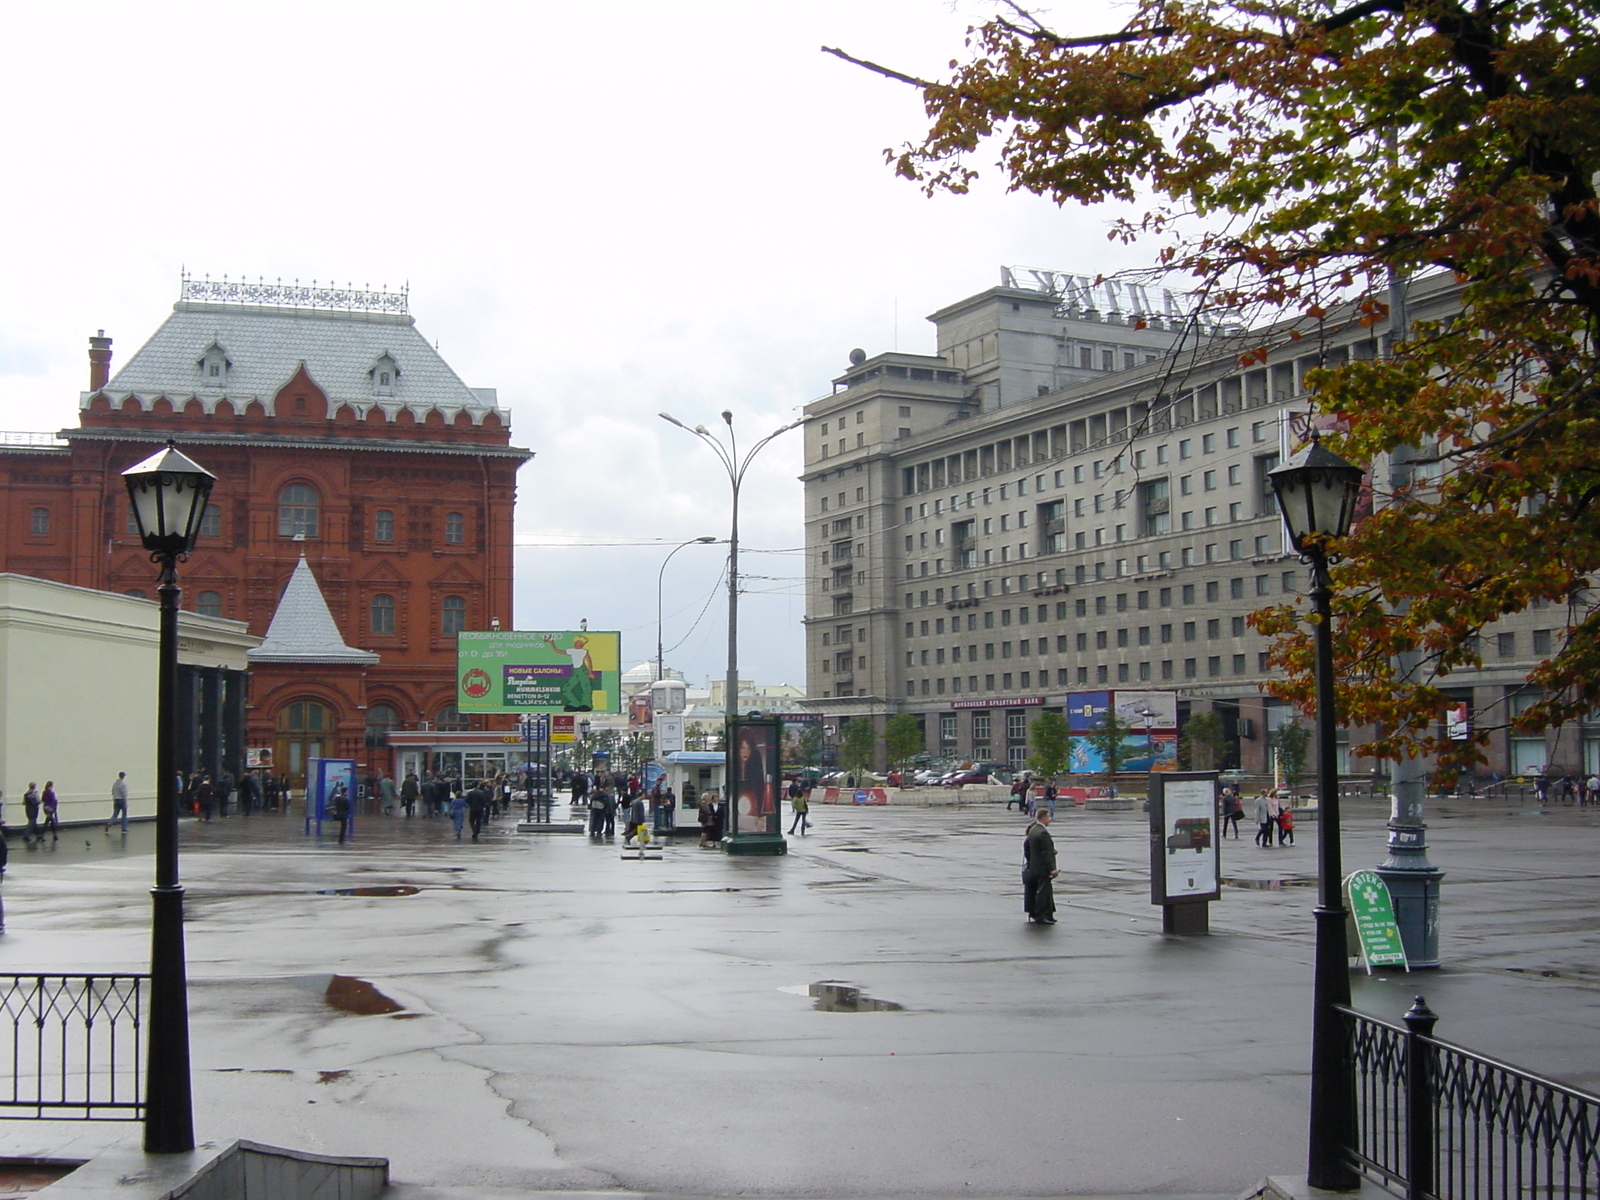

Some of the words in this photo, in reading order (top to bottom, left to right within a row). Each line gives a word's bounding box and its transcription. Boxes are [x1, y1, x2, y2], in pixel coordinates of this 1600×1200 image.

[458, 632, 536, 640] НЕОБЫКНОВЕННОЕ
[539, 632, 563, 641] ЧУДО
[1353, 874, 1382, 890] АПТЕКА
